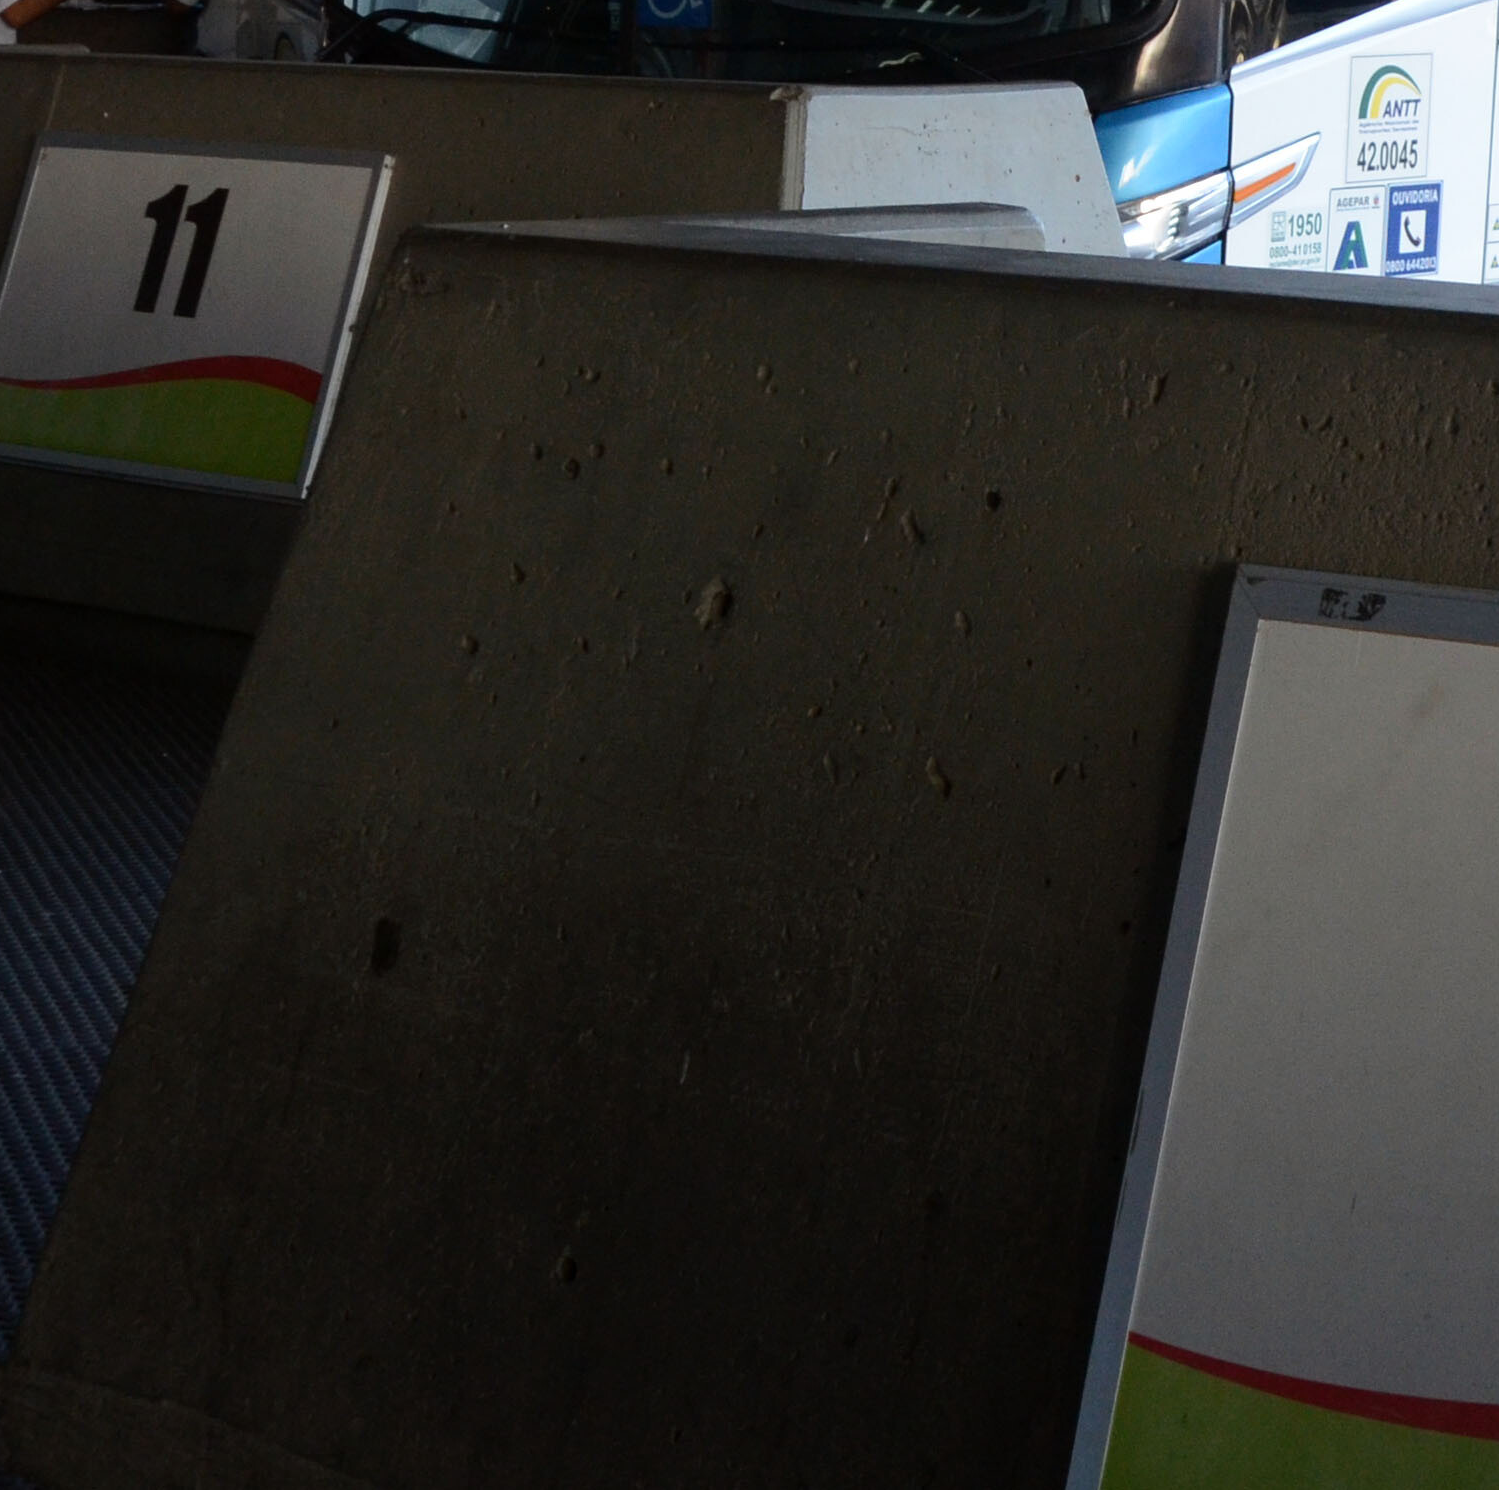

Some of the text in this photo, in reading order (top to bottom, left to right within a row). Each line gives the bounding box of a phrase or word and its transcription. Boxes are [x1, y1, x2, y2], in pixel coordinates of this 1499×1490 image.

[1382, 98, 1422, 120] ANTT
[1356, 138, 1419, 173] 42.0045
[1336, 195, 1371, 209] AGEPAR
[1391, 188, 1440, 207] OUVIDORIA
[1287, 212, 1323, 238] 1950
[132, 183, 230, 319] 11
[1385, 260, 1405, 274] 0800
